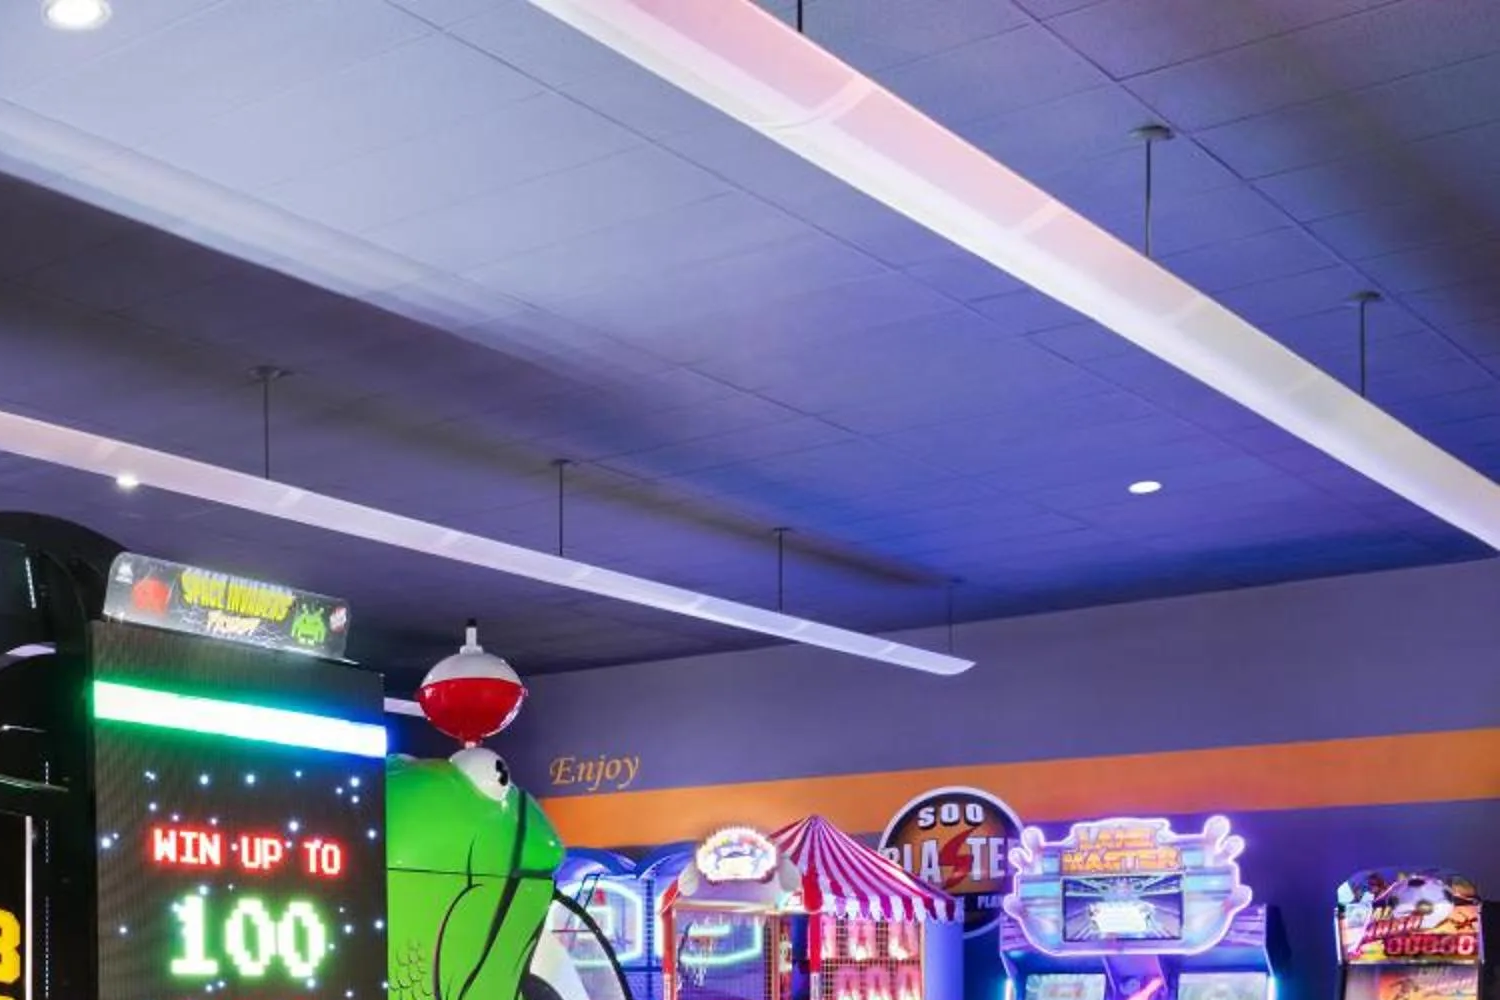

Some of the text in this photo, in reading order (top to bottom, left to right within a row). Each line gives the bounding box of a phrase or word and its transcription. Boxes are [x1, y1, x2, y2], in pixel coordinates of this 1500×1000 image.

[549, 754, 640, 792] Enjoy
[153, 828, 342, 875] WIN UP TO
[1061, 849, 1180, 874] MASTER
[170, 894, 326, 978] 100
